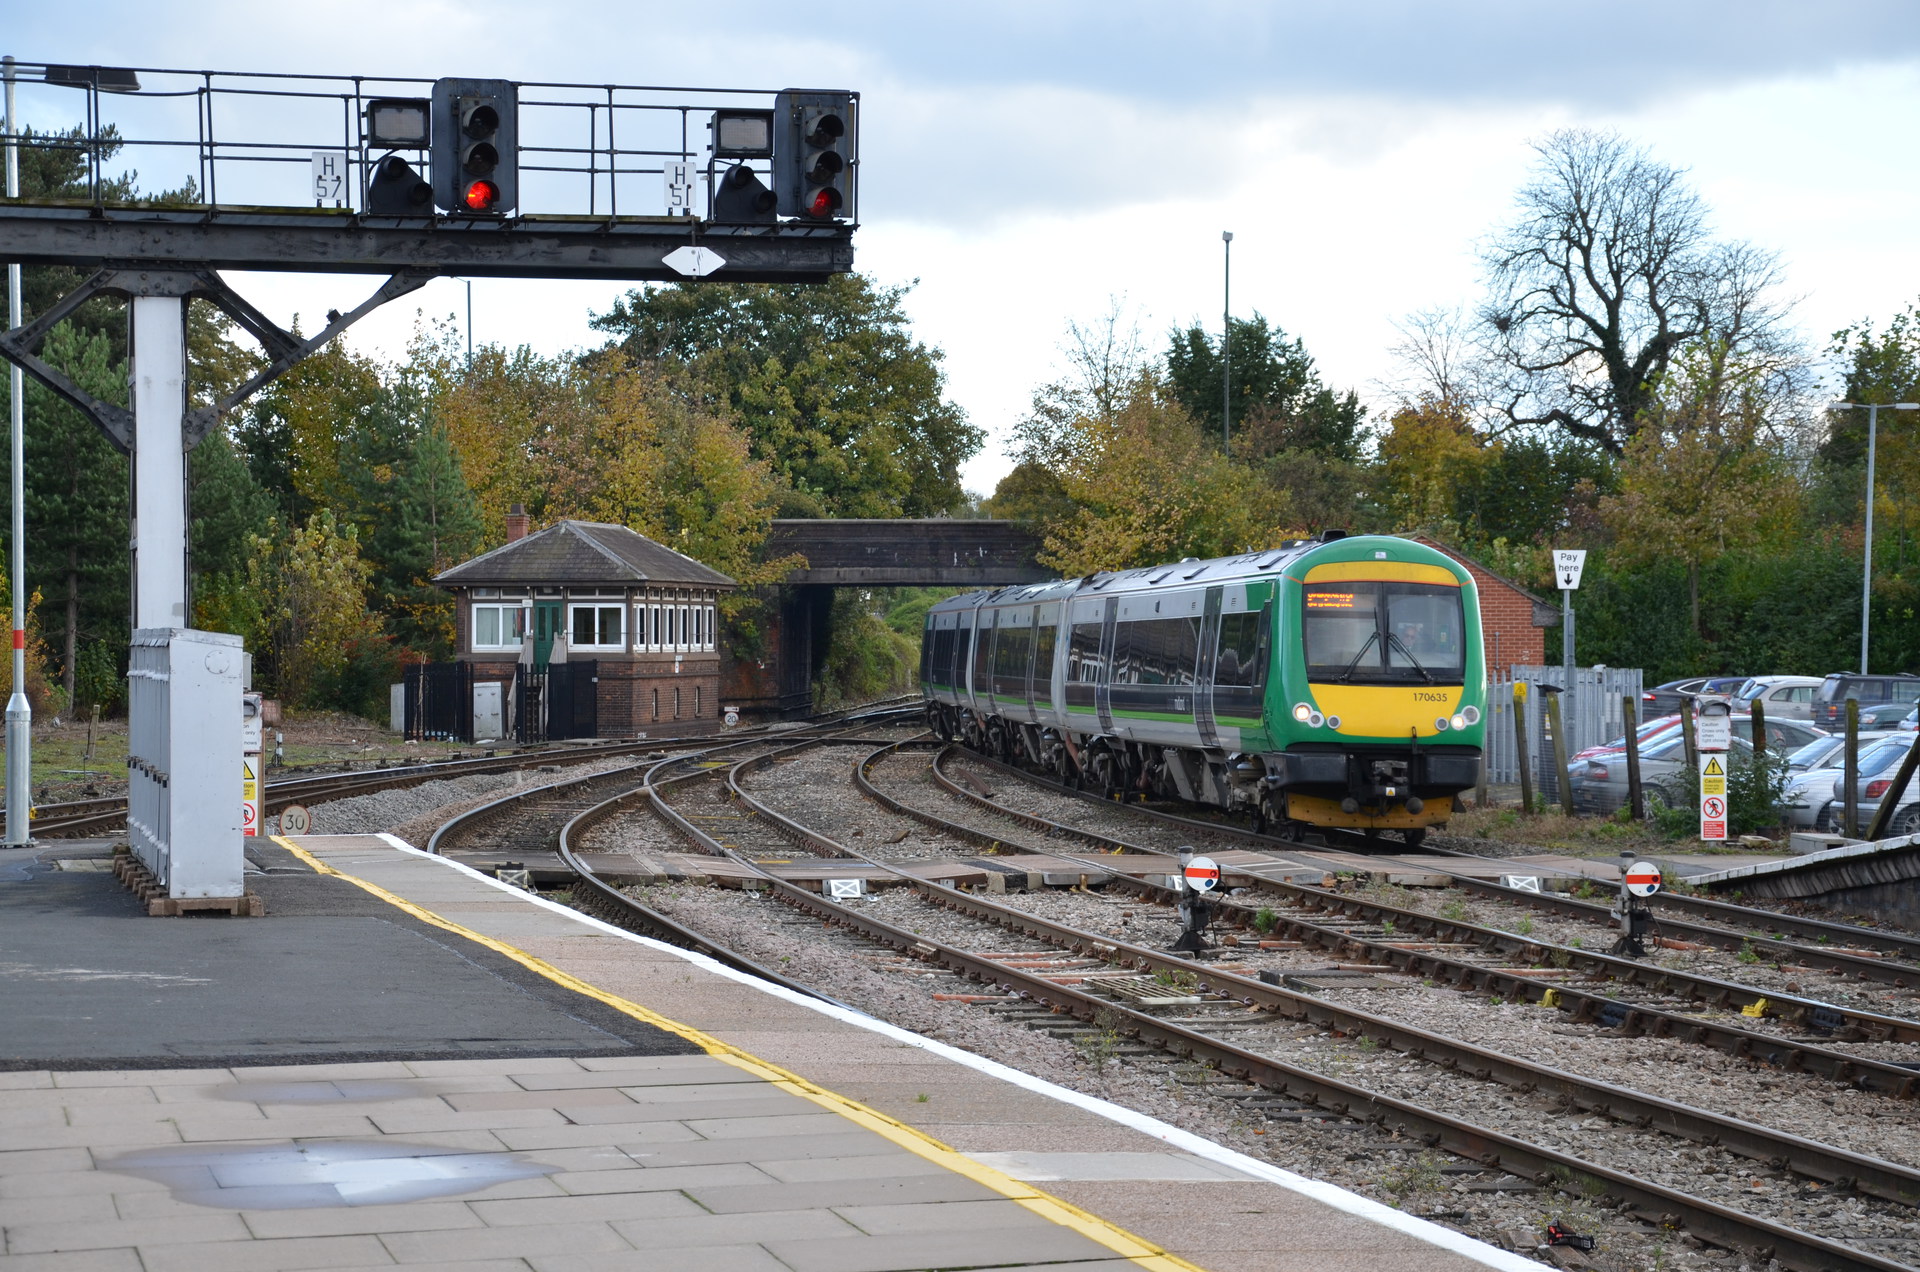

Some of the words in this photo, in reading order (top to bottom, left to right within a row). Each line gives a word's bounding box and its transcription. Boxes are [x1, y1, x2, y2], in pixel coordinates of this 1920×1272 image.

[323, 156, 335, 176] H
[675, 166, 686, 185] H
[316, 178, 342, 198] 57
[671, 187, 689, 206] 51
[1560, 552, 1578, 562] Pay
[1558, 564, 1579, 572] here
[1413, 692, 1448, 702] 170635
[727, 715, 736, 723] 20
[285, 814, 305, 830] 30
